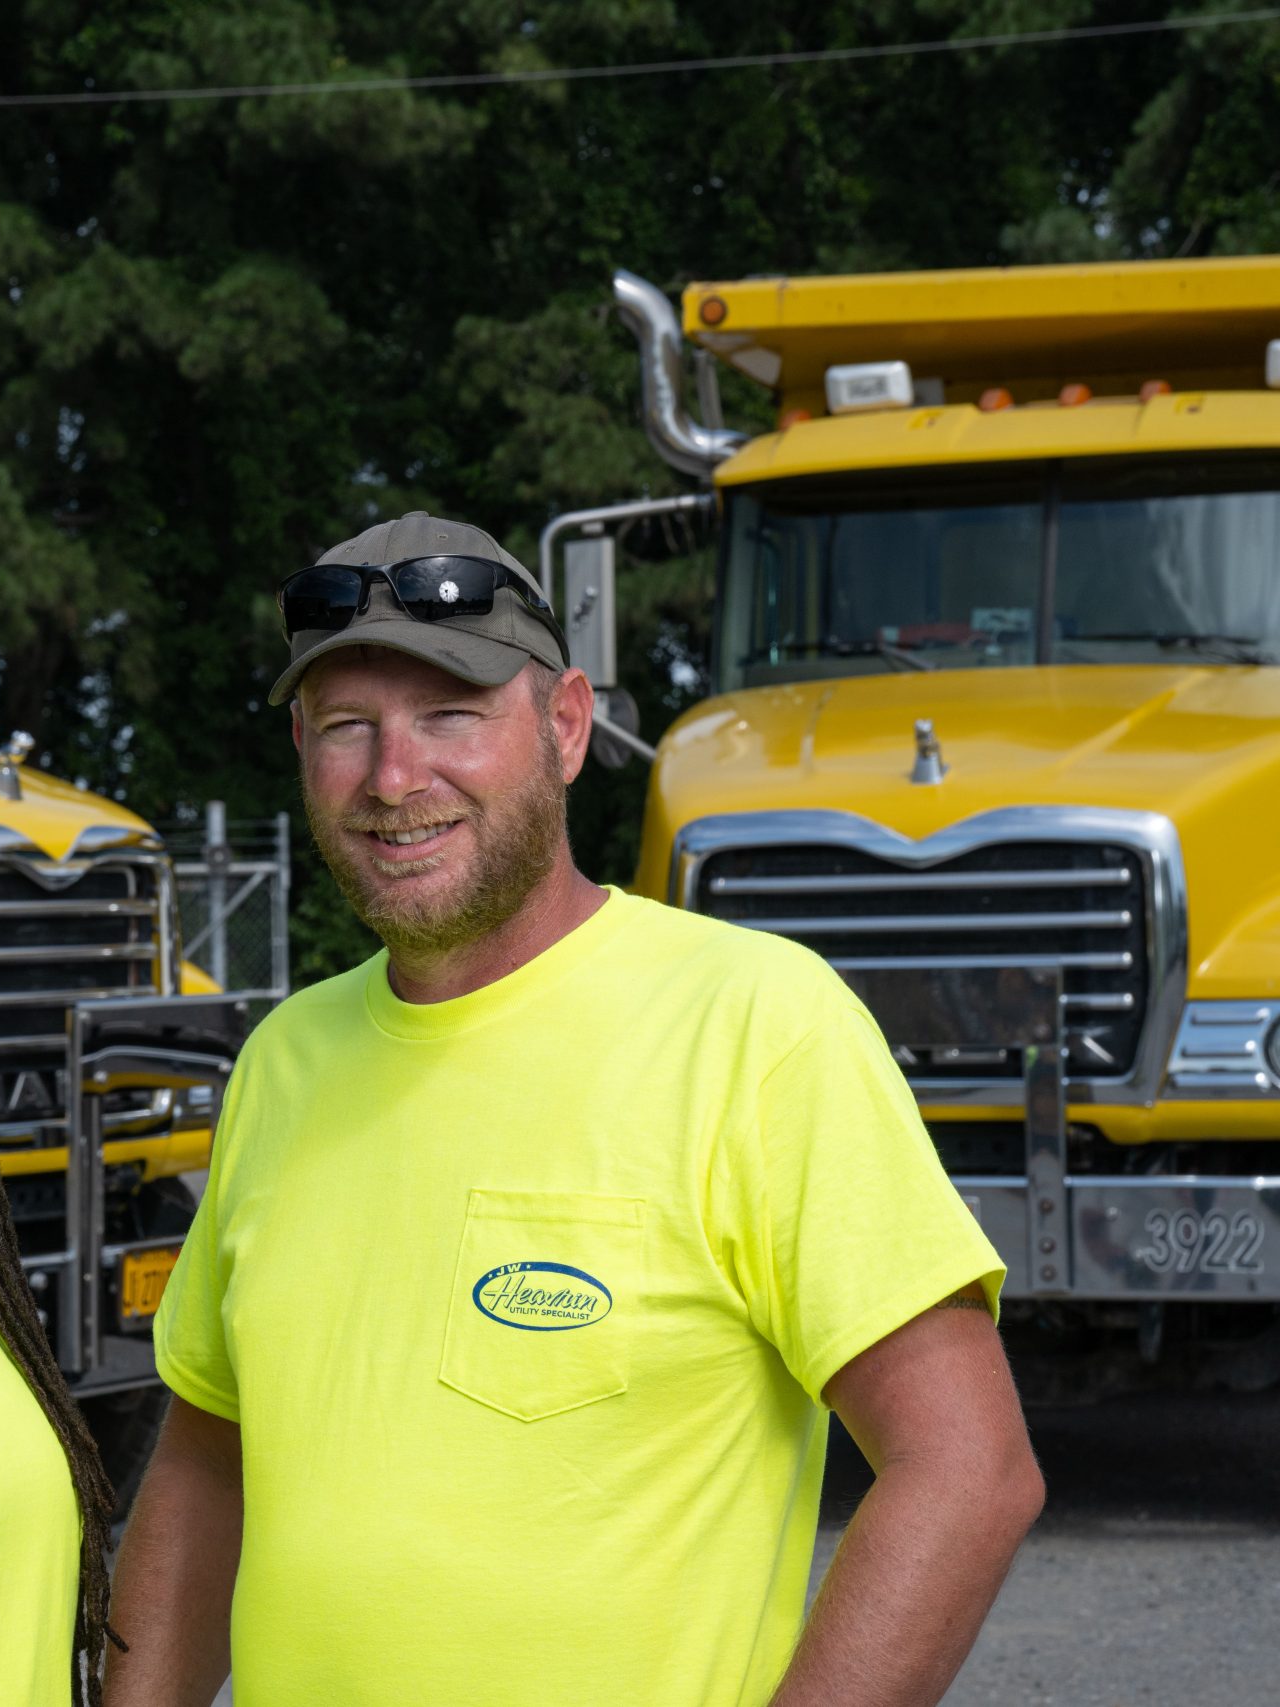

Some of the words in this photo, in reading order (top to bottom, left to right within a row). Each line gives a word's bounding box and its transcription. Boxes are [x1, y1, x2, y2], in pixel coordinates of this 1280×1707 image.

[1144, 1207, 1265, 1274] 3922
[496, 1263, 522, 1277] JW
[509, 1306, 539, 1316] UTILITY
[540, 1309, 591, 1321] SPECIALIST
